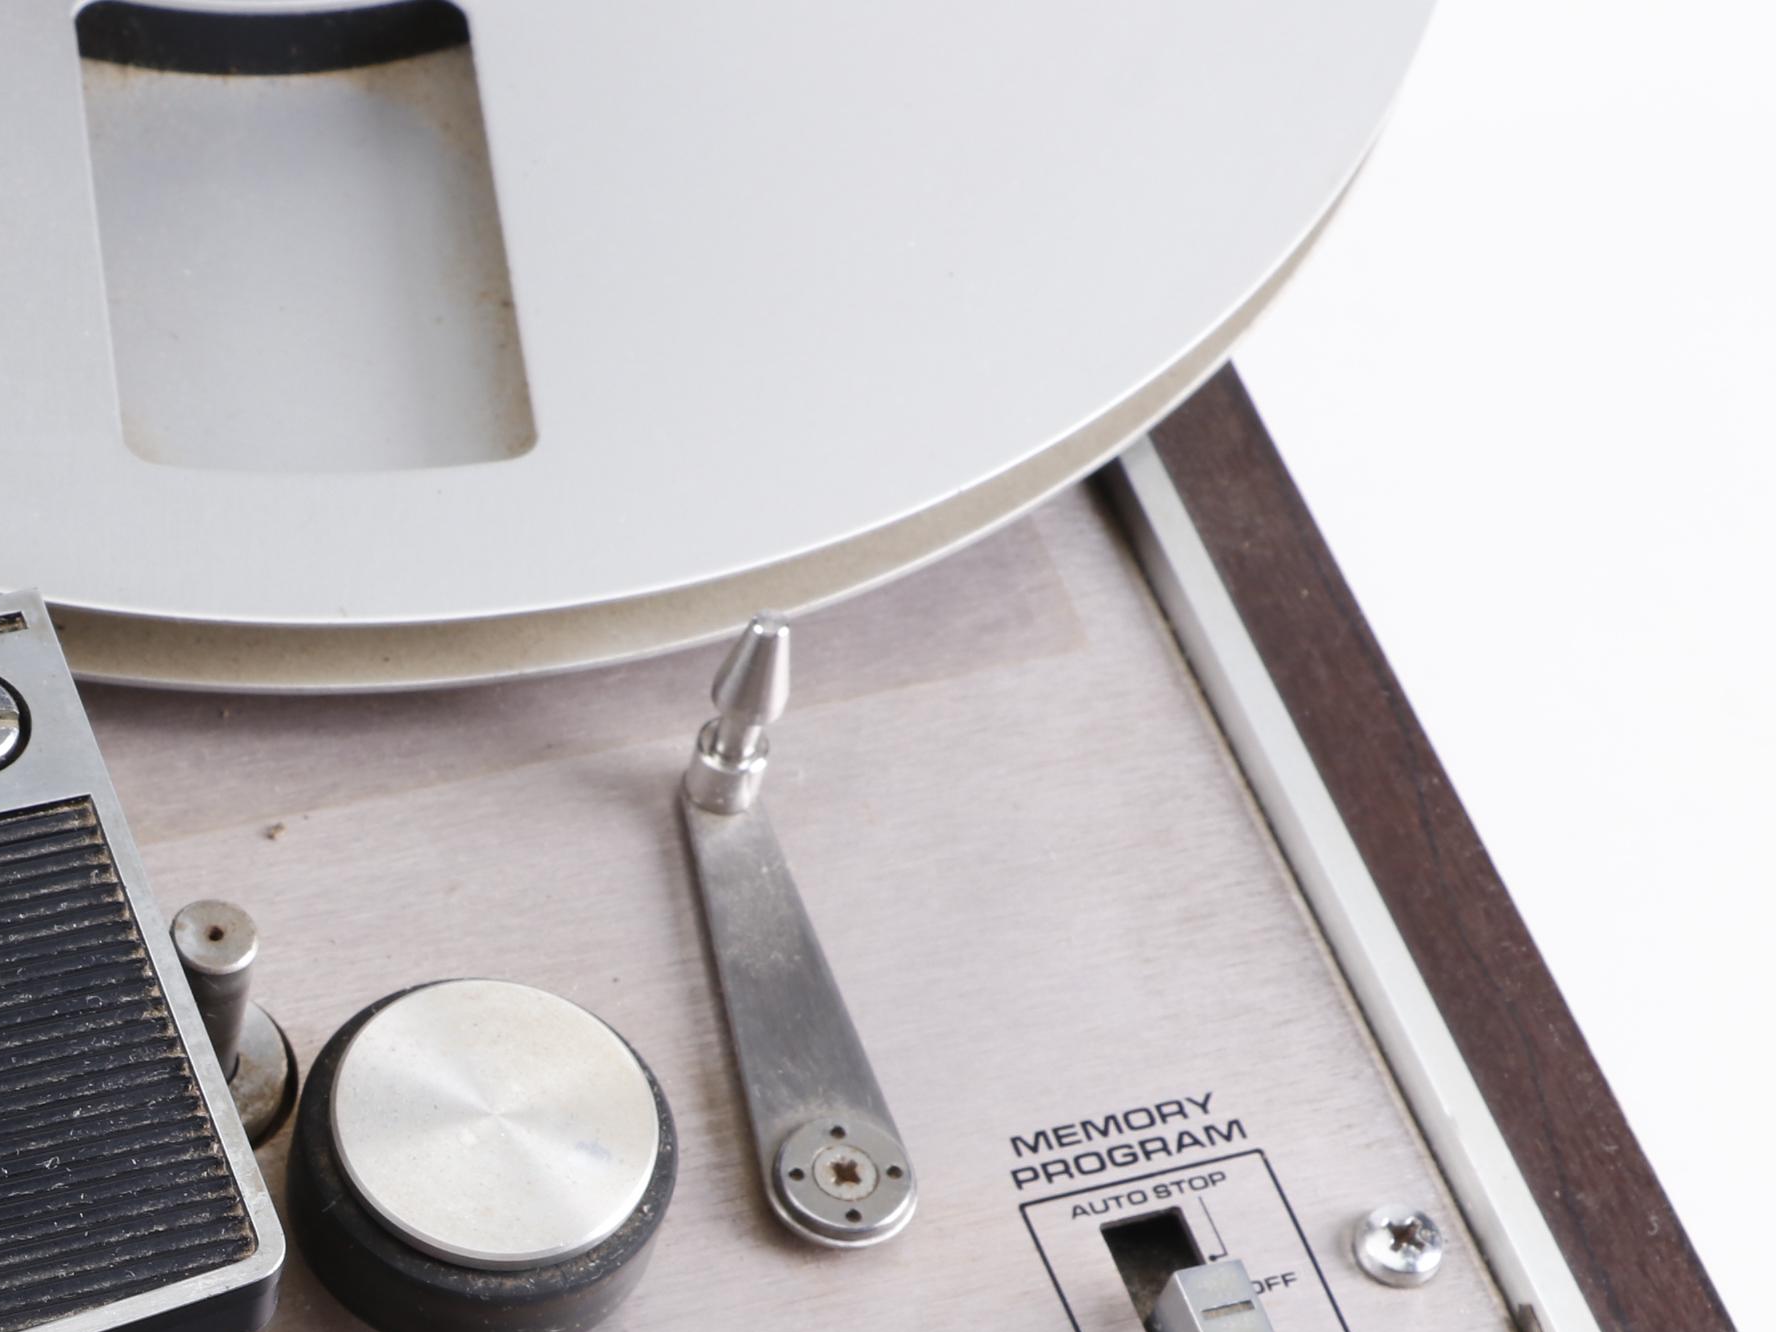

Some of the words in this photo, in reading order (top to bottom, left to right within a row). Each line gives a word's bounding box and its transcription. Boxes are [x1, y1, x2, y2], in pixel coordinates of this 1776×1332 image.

[1009, 1092, 1213, 1158] MEMORY
[1010, 1119, 1248, 1191] PROGRAM
[1070, 1189, 1148, 1220] AUTO
[1153, 1171, 1227, 1200] STOP
